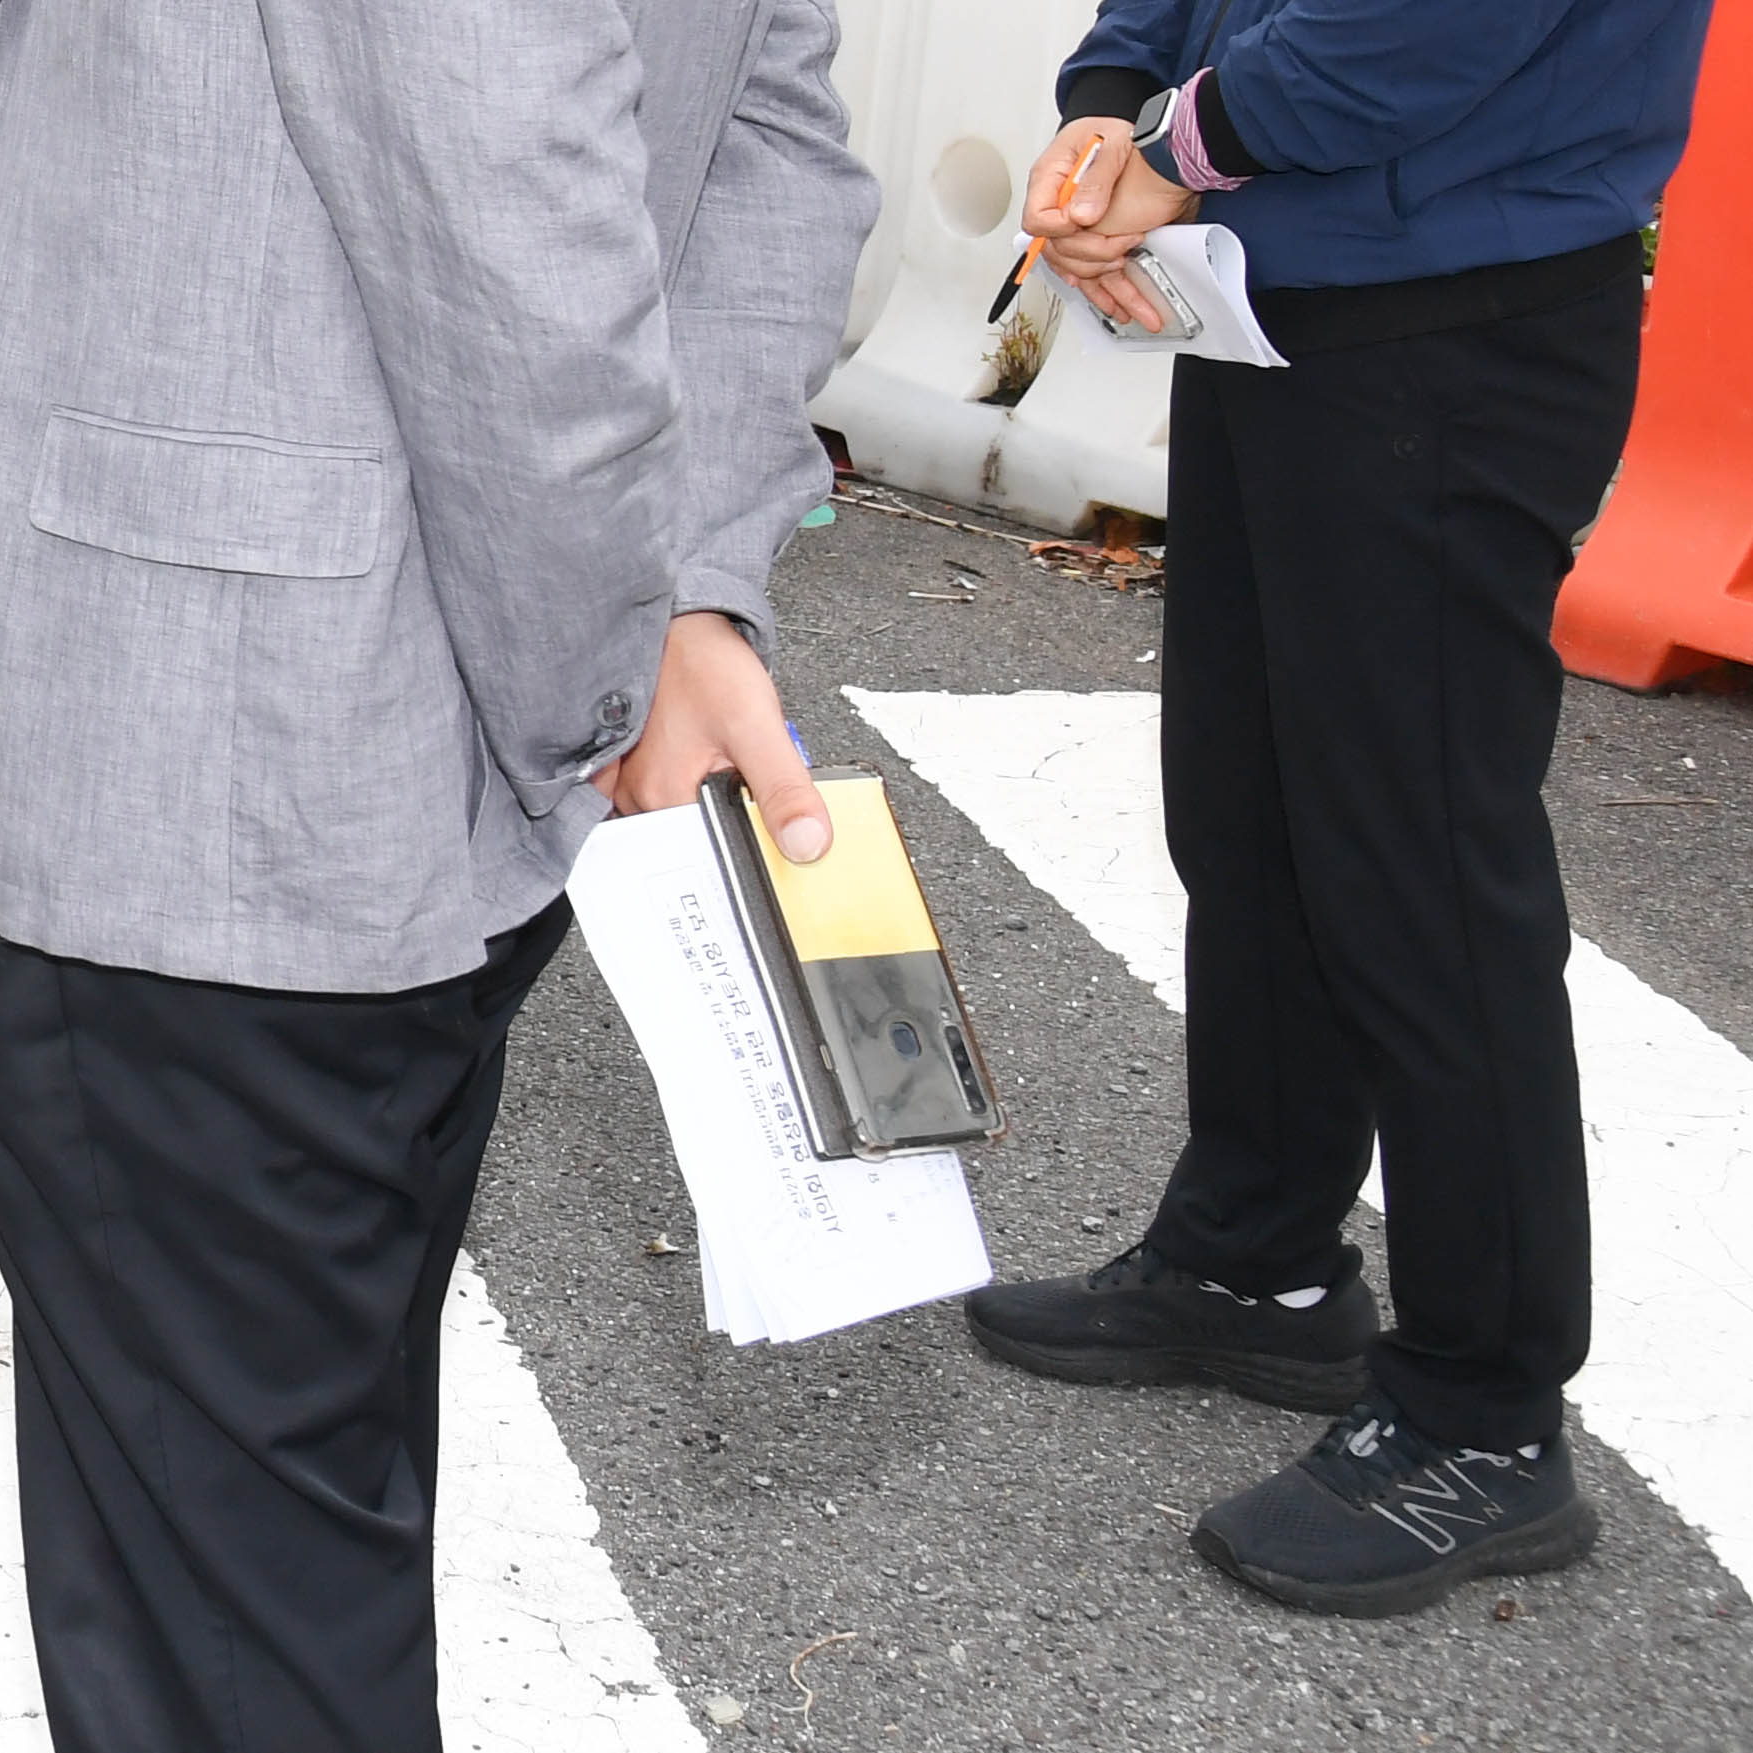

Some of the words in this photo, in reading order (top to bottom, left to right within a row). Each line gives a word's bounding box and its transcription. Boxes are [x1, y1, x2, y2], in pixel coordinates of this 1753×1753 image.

[680, 893, 708, 931] 보고
[703, 942, 750, 1017] 검토사항
[744, 1030, 772, 1068] 관련
[766, 1082, 811, 1162] 현장활동
[803, 1173, 842, 1231] 시의회
